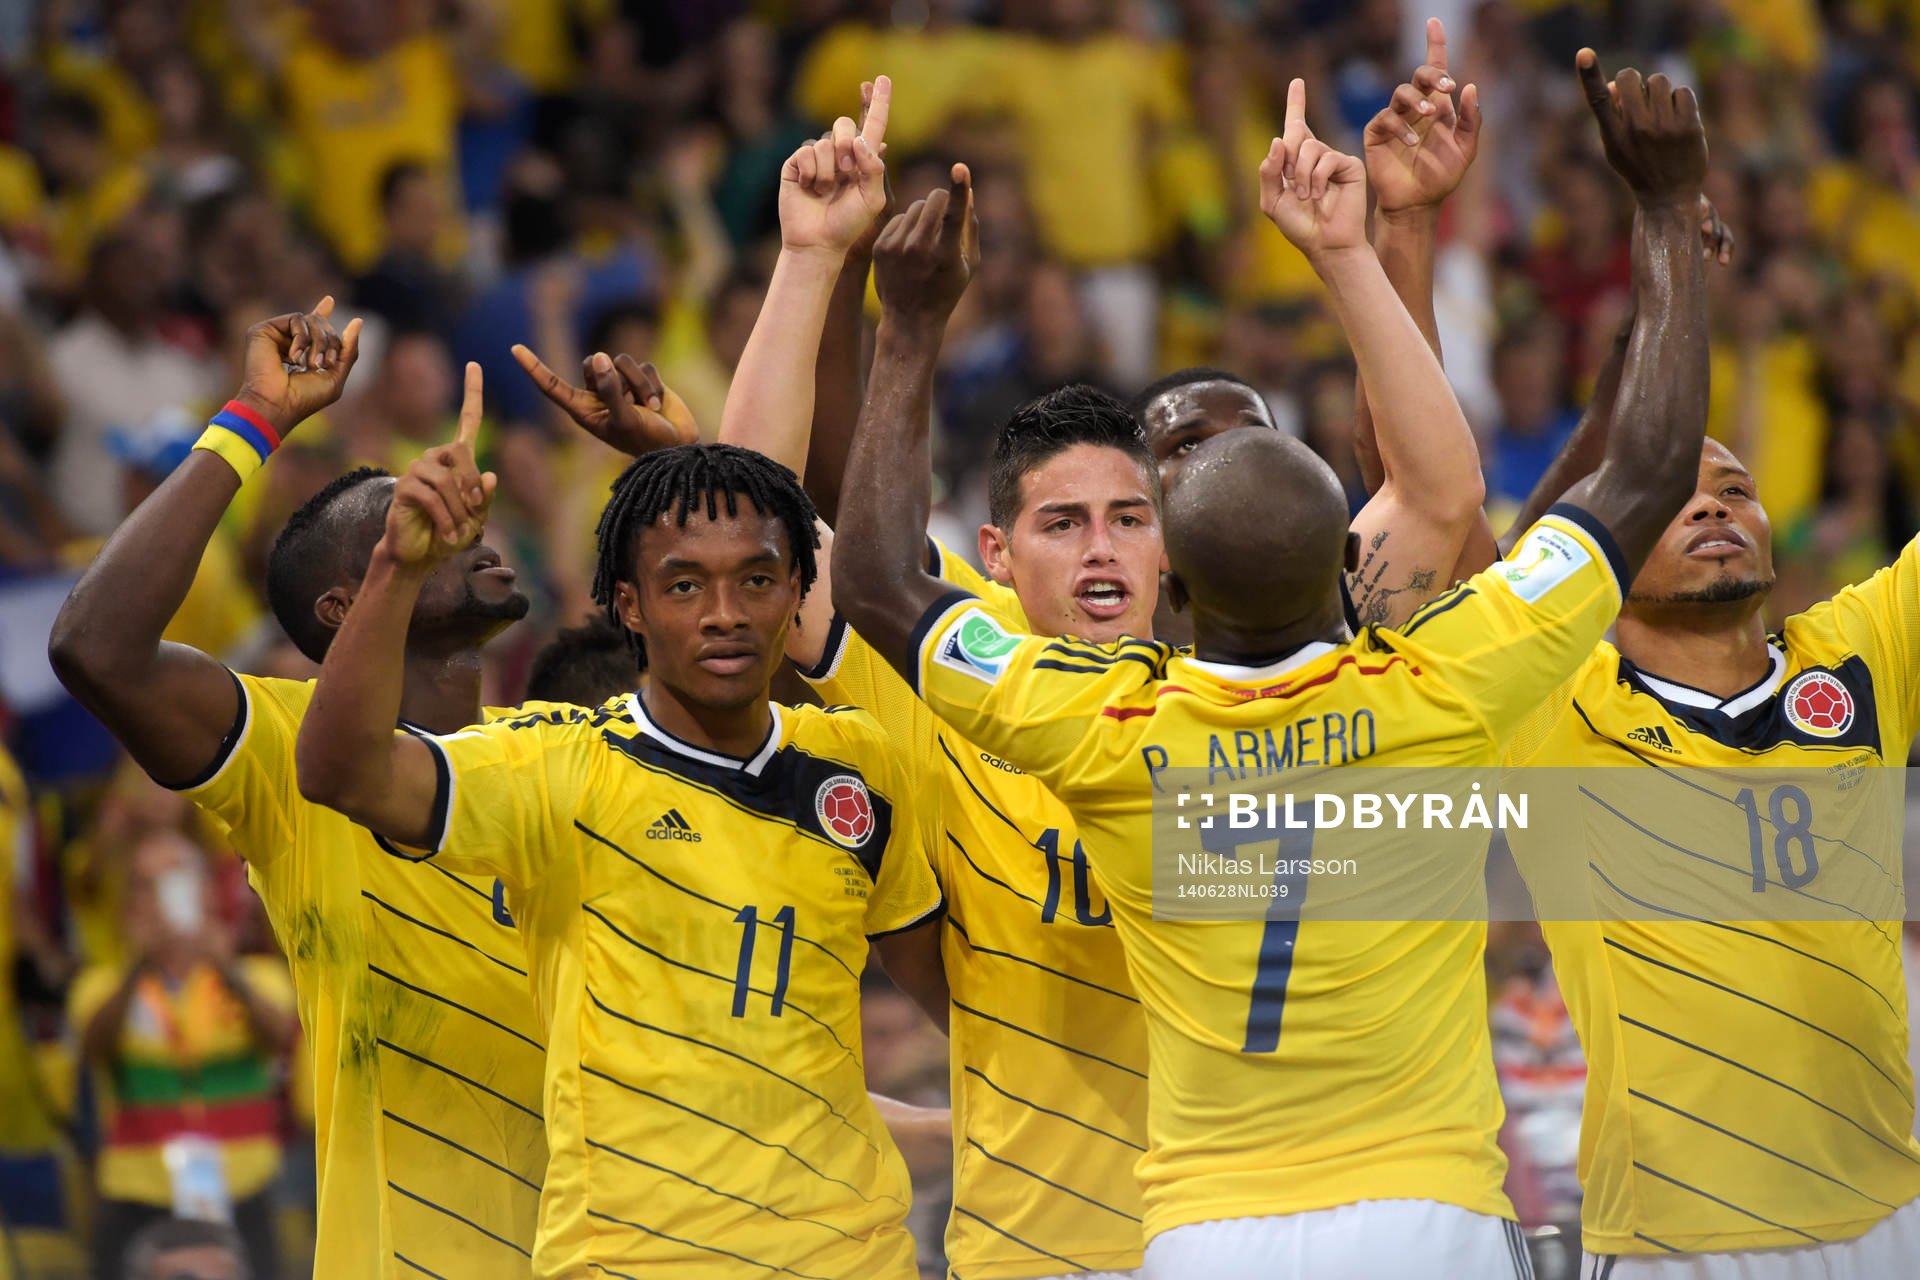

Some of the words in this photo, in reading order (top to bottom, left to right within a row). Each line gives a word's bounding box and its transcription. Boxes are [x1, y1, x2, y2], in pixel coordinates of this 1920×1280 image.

[1208, 708, 1376, 786] ARMERO
[1626, 732, 1682, 754] adidas
[646, 826, 702, 843] adidas
[1734, 784, 1820, 893] 18
[731, 904, 796, 1018] 11
[1197, 799, 1316, 1053] 7
